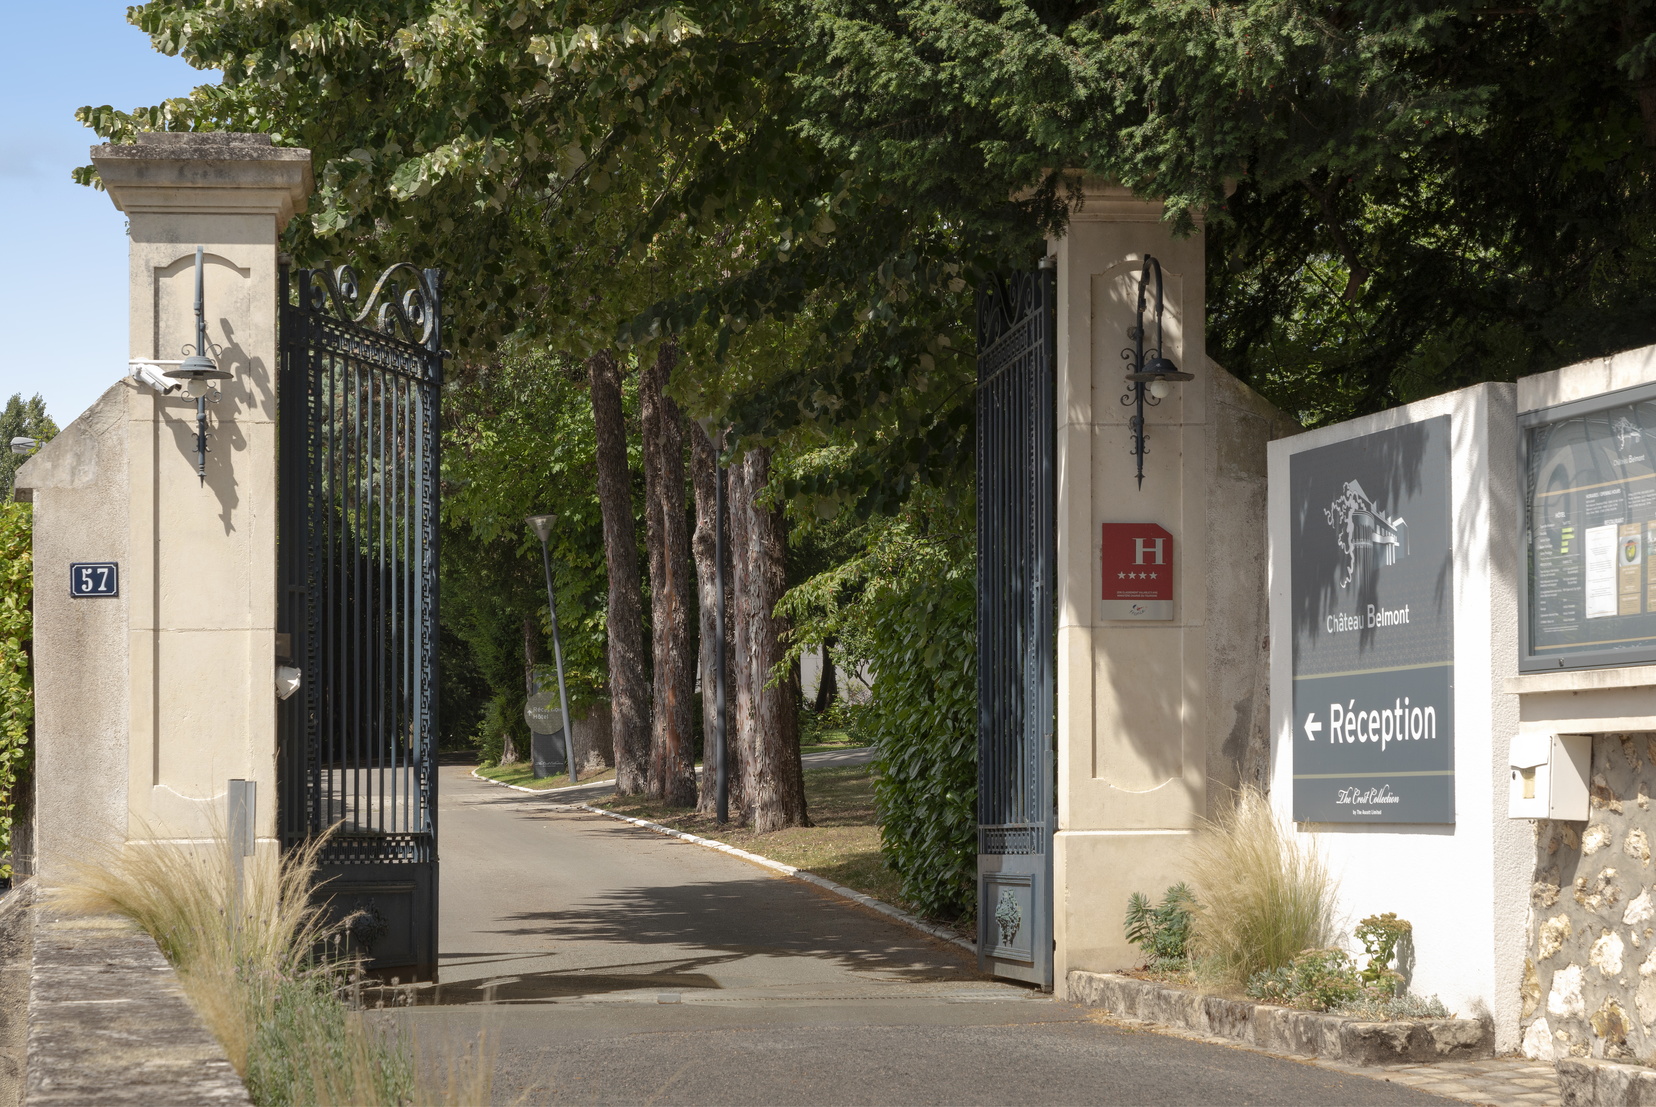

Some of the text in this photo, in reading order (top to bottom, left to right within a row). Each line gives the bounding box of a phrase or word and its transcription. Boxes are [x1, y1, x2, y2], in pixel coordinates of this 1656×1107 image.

[1132, 538, 1166, 565] H
[81, 567, 109, 592] 57
[1326, 603, 1410, 634] Château Belmont
[1330, 696, 1437, 752] Réception
[1336, 783, 1400, 805] The Crest Collection
